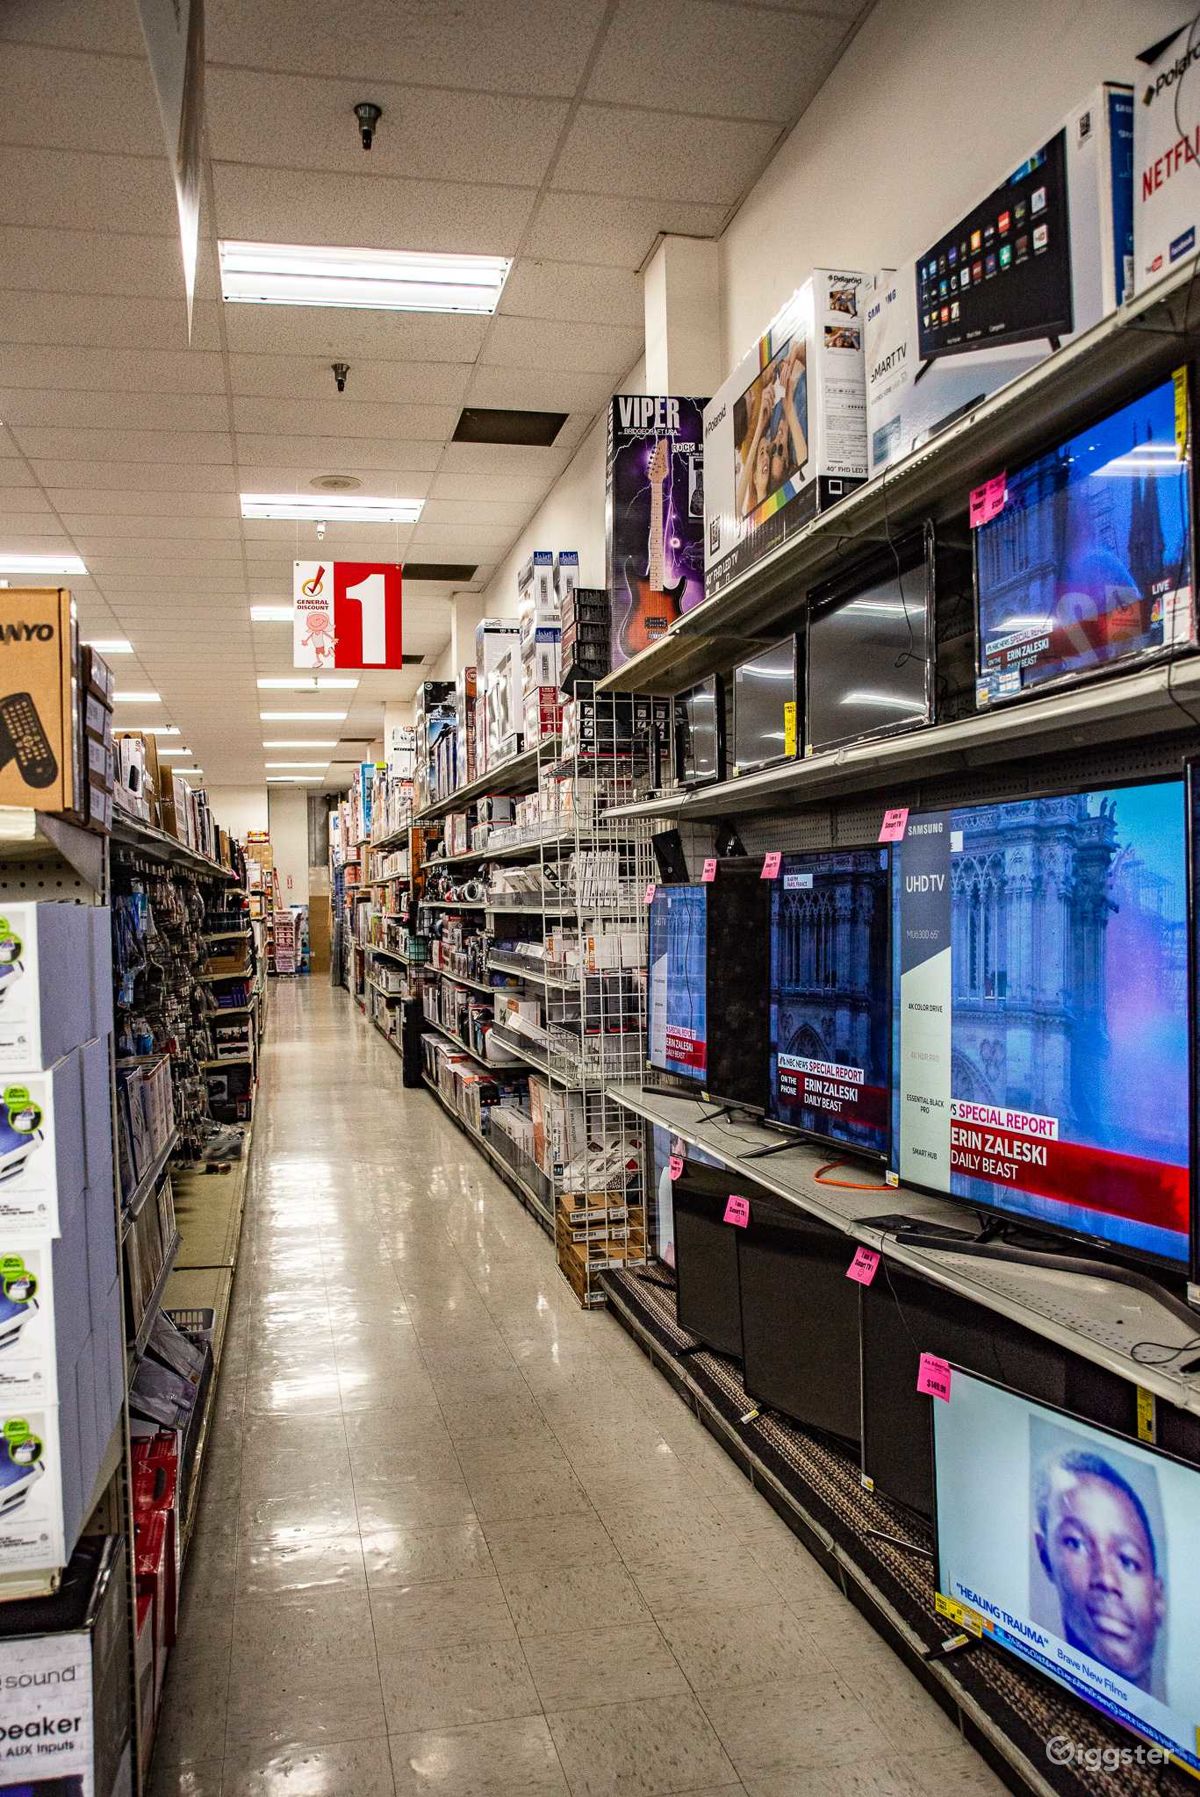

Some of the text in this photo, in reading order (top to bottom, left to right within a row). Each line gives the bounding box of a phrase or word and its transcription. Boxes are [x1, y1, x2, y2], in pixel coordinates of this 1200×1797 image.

[619, 397, 680, 428] VIPER
[672, 443, 695, 452] ROCK
[1152, 578, 1170, 595] LIVE
[346, 573, 386, 664] 1
[1007, 638, 1049, 661] ERIN ZALESKI
[908, 823, 943, 836] SAMSUNG
[914, 1003, 929, 1012] COLOR
[929, 1005, 943, 1013] DRIVE
[676, 1040, 693, 1052] ZALESKI
[788, 1076, 796, 1084] THE
[809, 1061, 835, 1076] SPECIAL
[835, 1066, 862, 1082] REPORT
[781, 1085, 796, 1095] PHONE
[805, 1078, 858, 1102] ERIN ZALESKI
[804, 1093, 842, 1112] DAILY BEAST
[906, 1094, 944, 1107] ESSENTIAL BLACK
[920, 1106, 930, 1114] PRO
[958, 1103, 1004, 1126] SPECIAL
[1006, 1112, 1055, 1136] REPORT
[912, 1148, 937, 1160] SMART HUB
[951, 1127, 1047, 1166] ERIN ZALESKI
[951, 1150, 1018, 1180] DAILY BEAST
[956, 1582, 1001, 1619] "HEALING
[1001, 1611, 1049, 1647] TRAUMA"
[1057, 1648, 1128, 1700] Brave New Films
[6, 1741, 74, 1757] AUX Inputs
